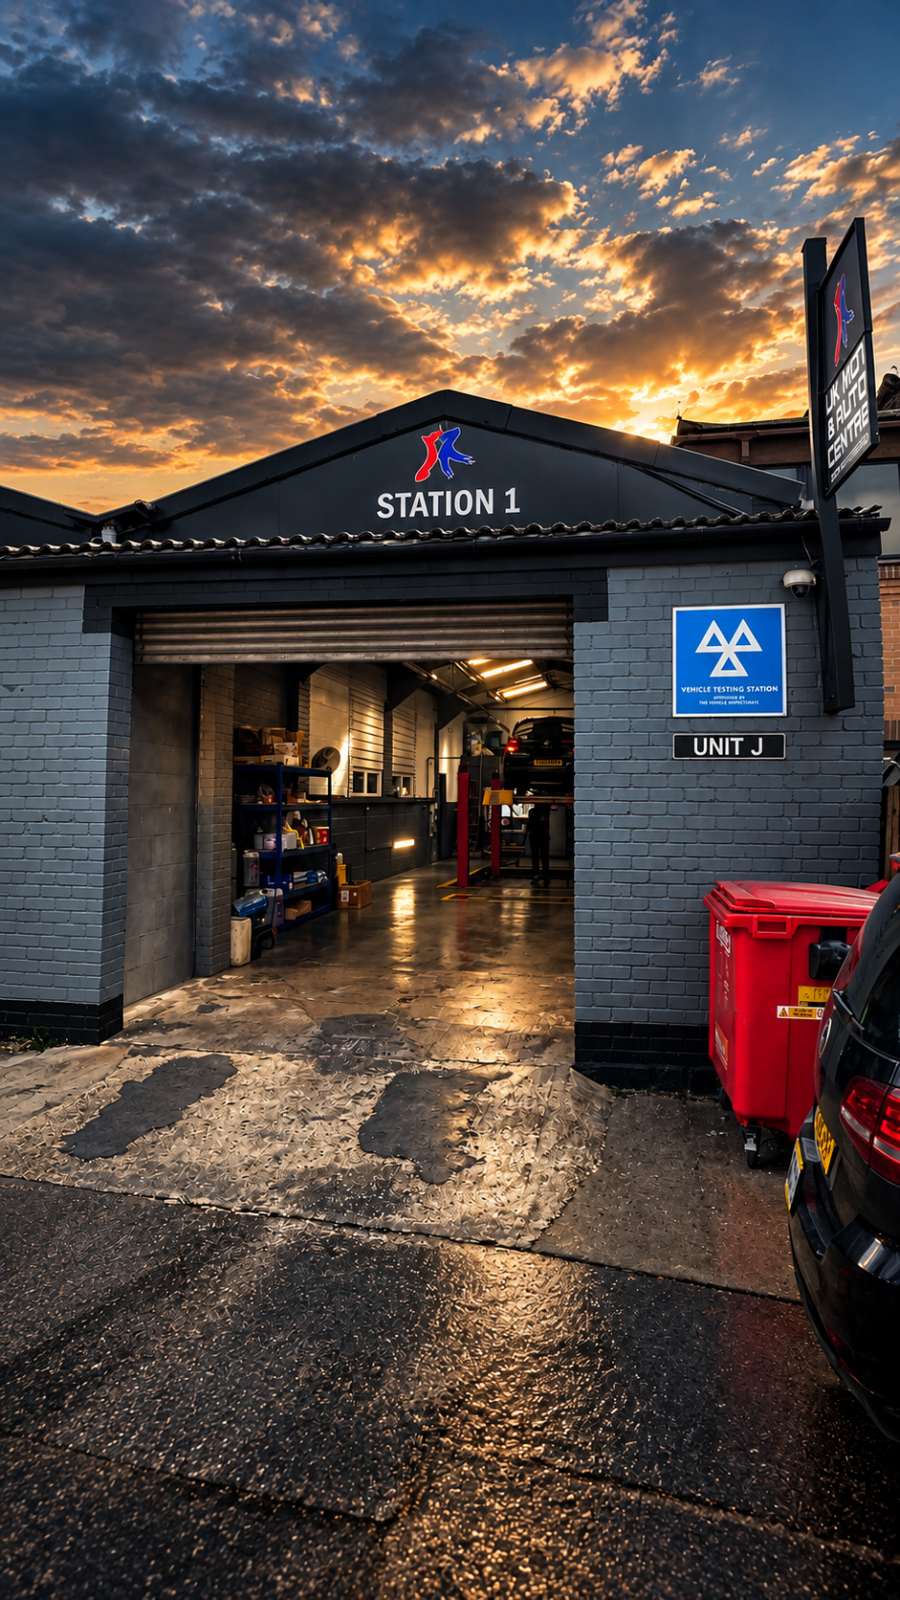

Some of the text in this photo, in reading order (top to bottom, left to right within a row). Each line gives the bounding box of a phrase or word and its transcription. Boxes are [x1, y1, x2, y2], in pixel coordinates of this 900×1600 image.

[828, 417, 835, 440] &
[836, 370, 867, 431] AUTO
[827, 400, 869, 469] CENTRE
[376, 487, 521, 519] STATION 1
[713, 685, 745, 693] TESTING
[693, 737, 763, 756] UNIT J
